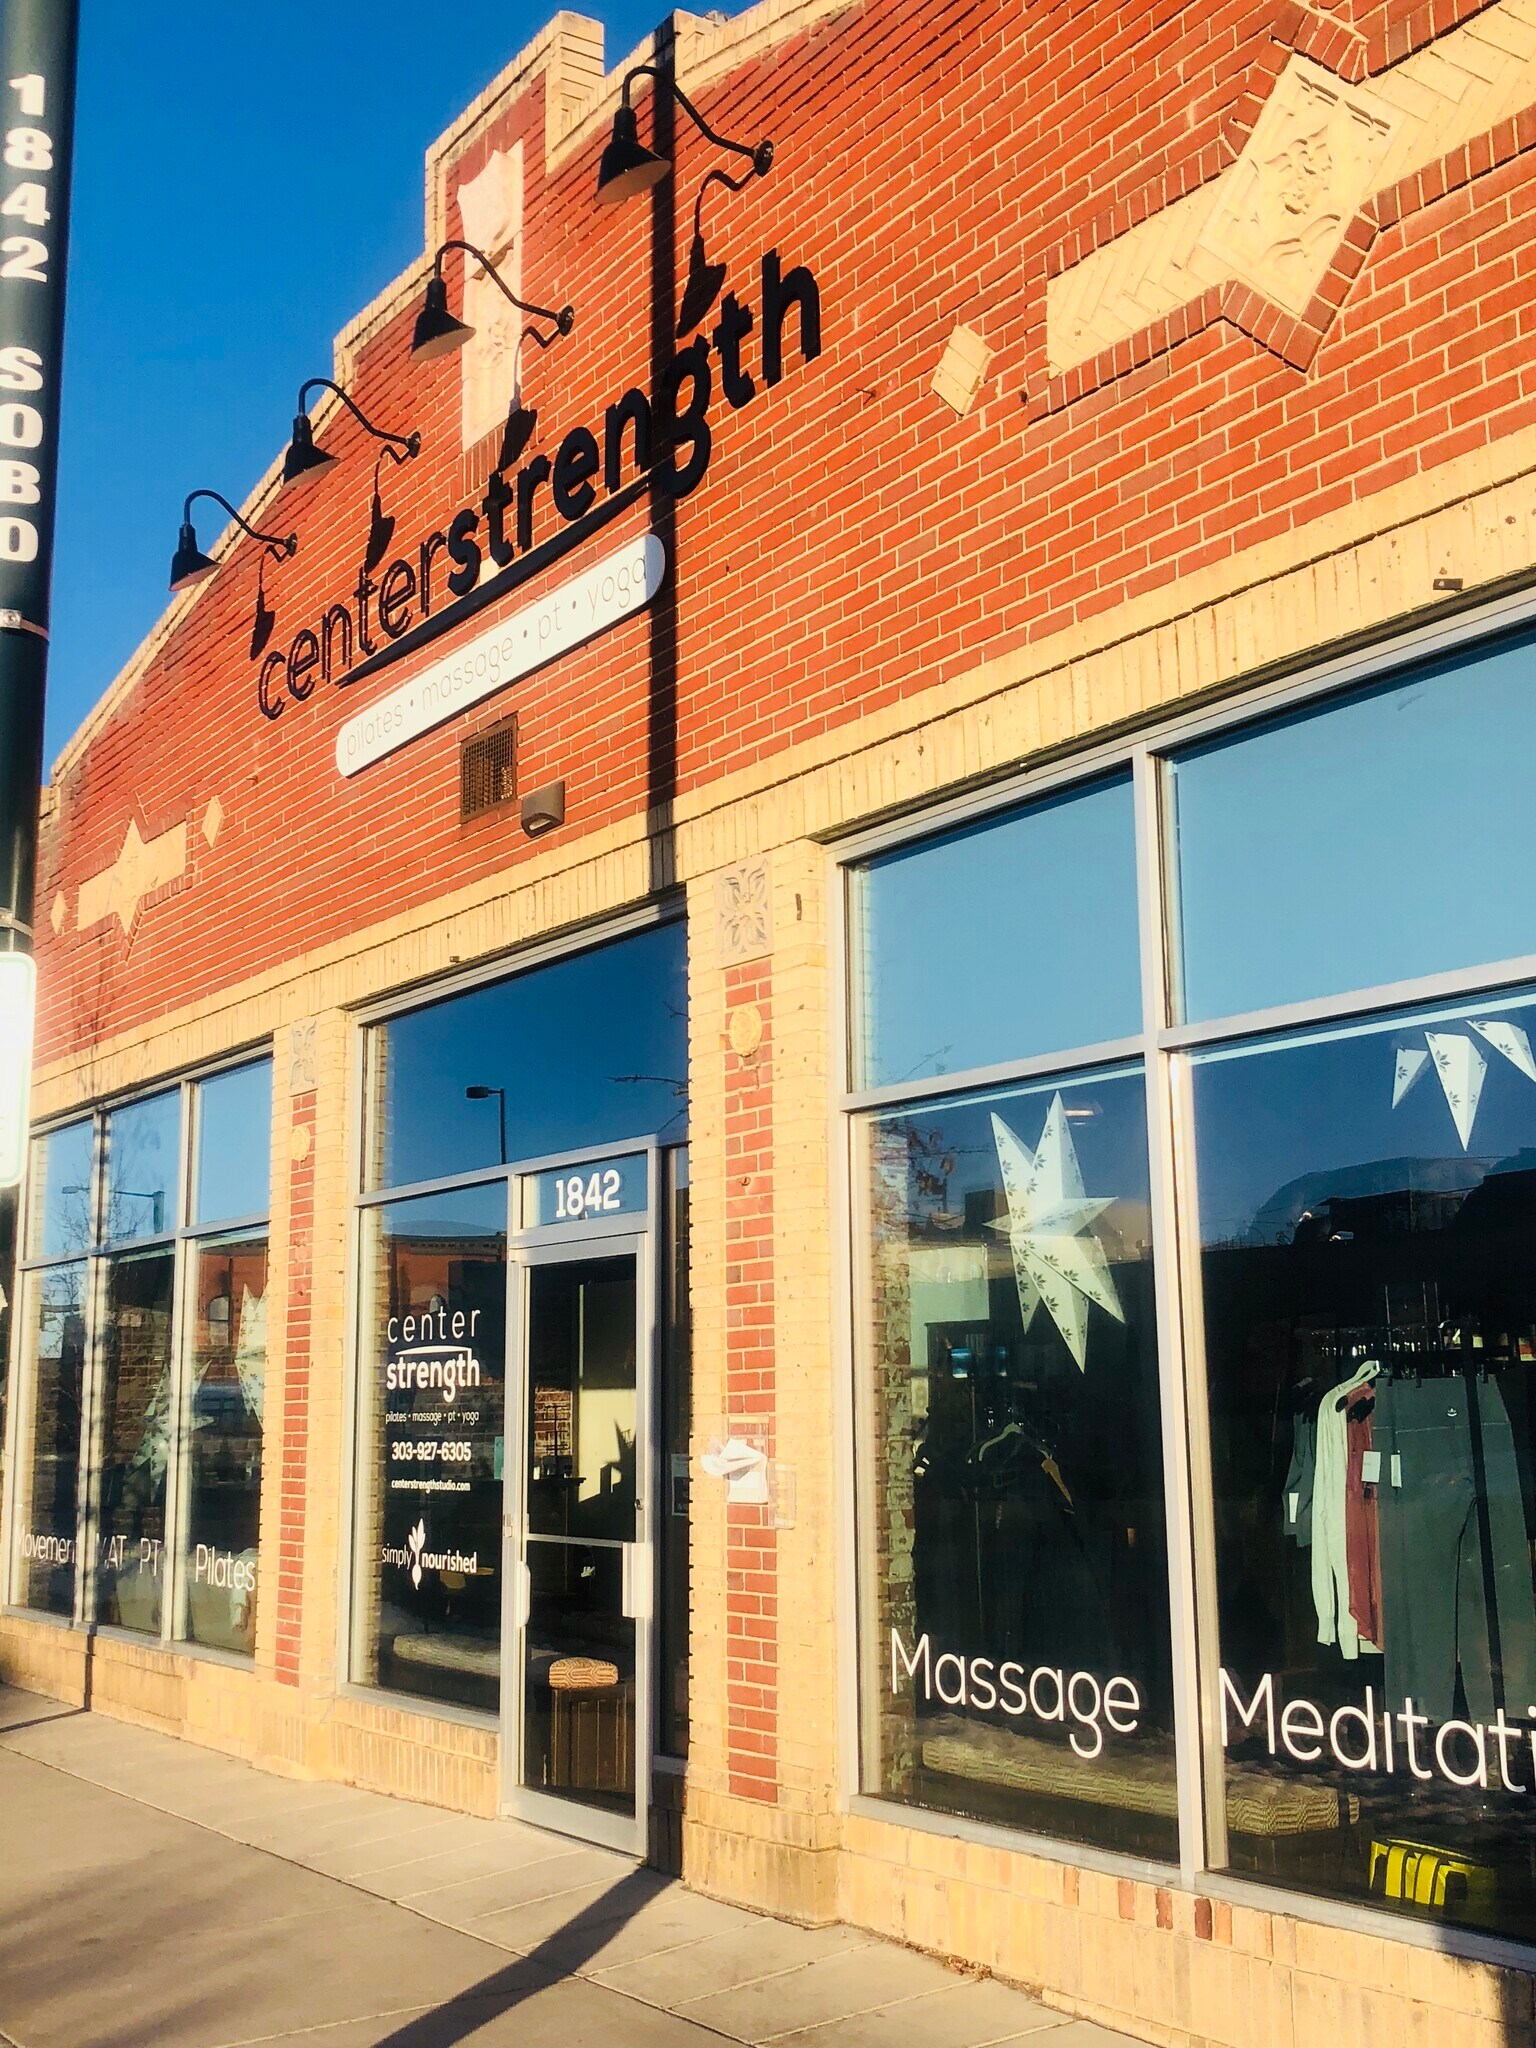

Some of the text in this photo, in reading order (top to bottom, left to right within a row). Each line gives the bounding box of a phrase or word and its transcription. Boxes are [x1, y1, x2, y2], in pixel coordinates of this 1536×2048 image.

[1, 74, 53, 283] 1842
[346, 552, 647, 764] pilates massage pt yoga
[554, 1169, 621, 1218] 1842
[387, 1305, 481, 1343] center
[386, 1350, 481, 1403] strength
[385, 1411, 480, 1426] pilates massage pt yoga
[391, 1441, 472, 1461] 303-927-6305
[391, 1479, 471, 1494] centerstrengthstudio.com
[16, 1524, 79, 1564] Movemen
[139, 1537, 162, 1576] PT
[381, 1543, 478, 1573] simply nourished
[194, 1543, 256, 1592] Pilates
[890, 1628, 1140, 1759] Massage
